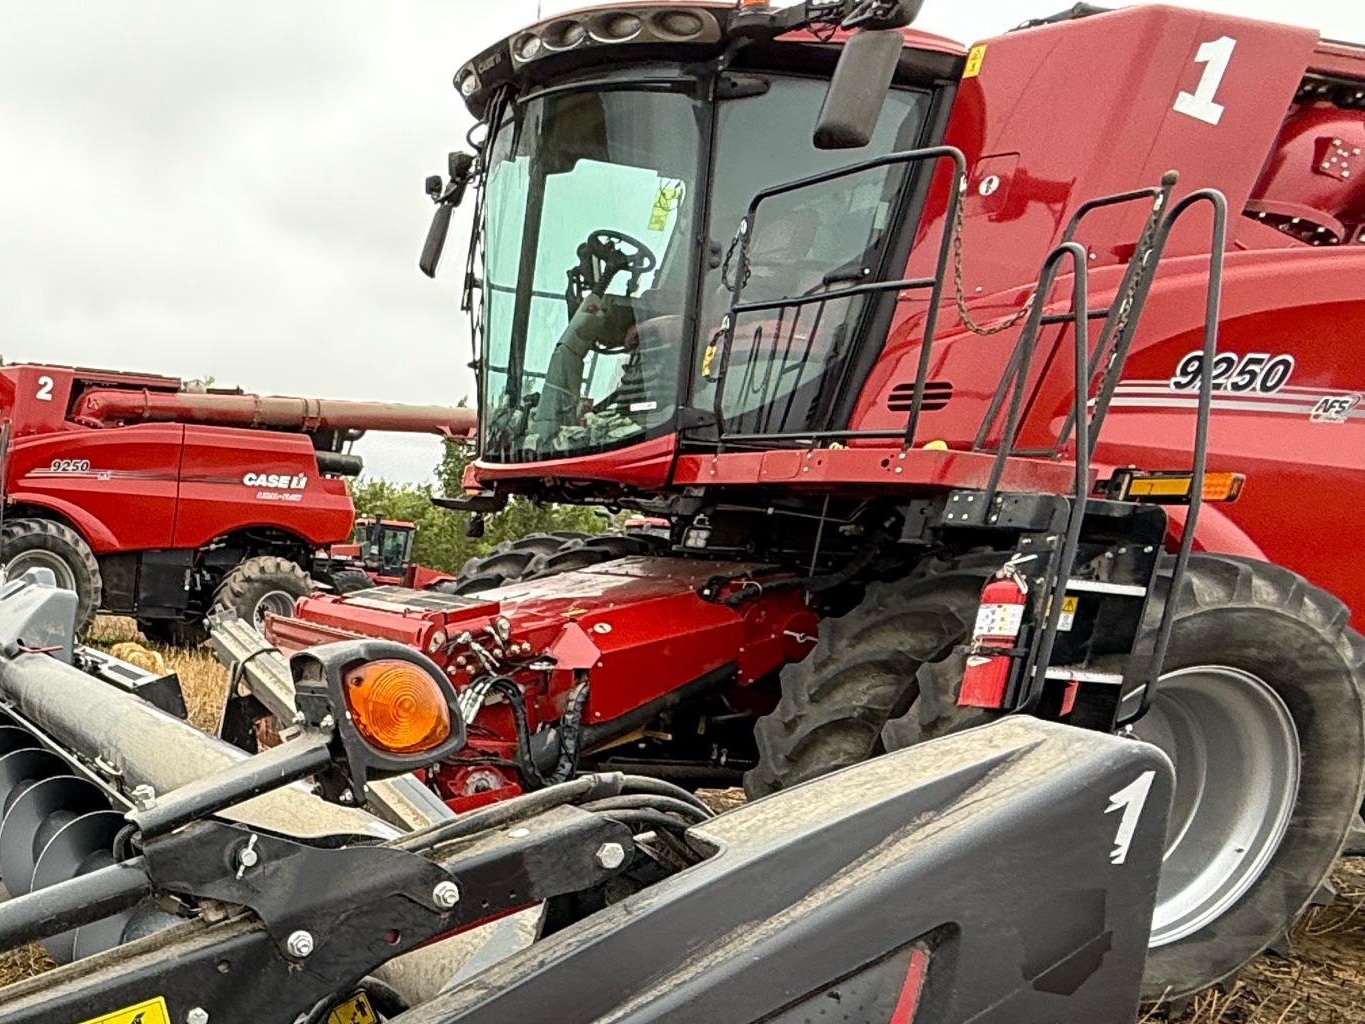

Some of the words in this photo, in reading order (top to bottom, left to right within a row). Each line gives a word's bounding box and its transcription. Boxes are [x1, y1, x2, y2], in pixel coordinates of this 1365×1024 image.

[1173, 36, 1237, 125] 1
[1170, 351, 1295, 394] 9250
[35, 376, 54, 401] 2
[1312, 397, 1352, 415] AFS
[51, 459, 91, 472] 9250
[243, 472, 291, 488] CASE
[1104, 771, 1156, 864] 1
